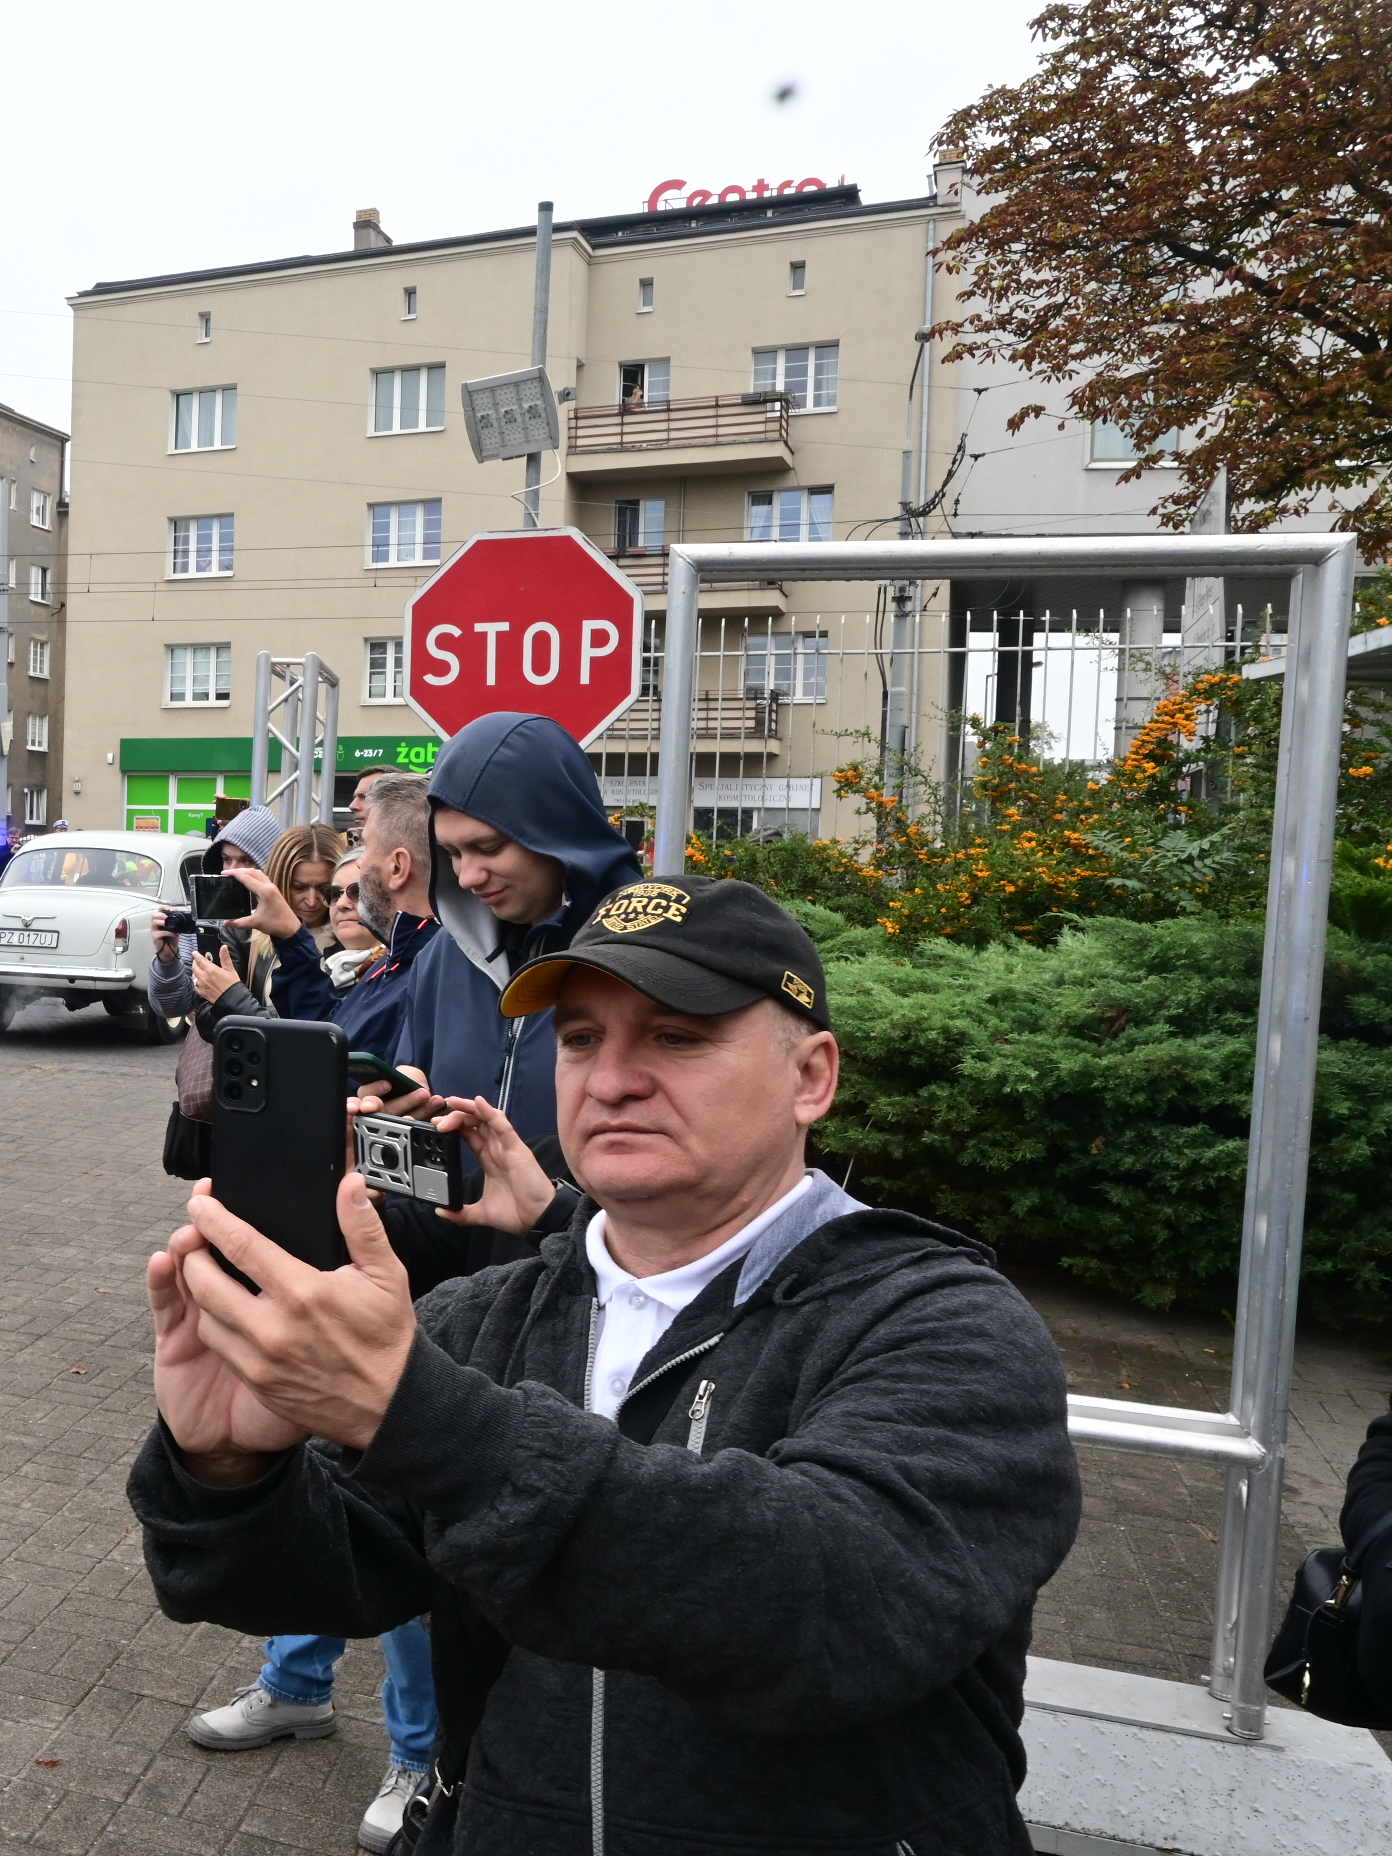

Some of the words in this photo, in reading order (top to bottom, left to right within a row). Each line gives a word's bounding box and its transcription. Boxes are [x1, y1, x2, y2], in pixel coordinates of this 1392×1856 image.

[423, 619, 620, 686] STOP
[354, 748, 384, 758] 6-23/7
[592, 897, 688, 925] FORCE
[0, 931, 15, 944] PZ
[18, 932, 54, 946] 017UJ
